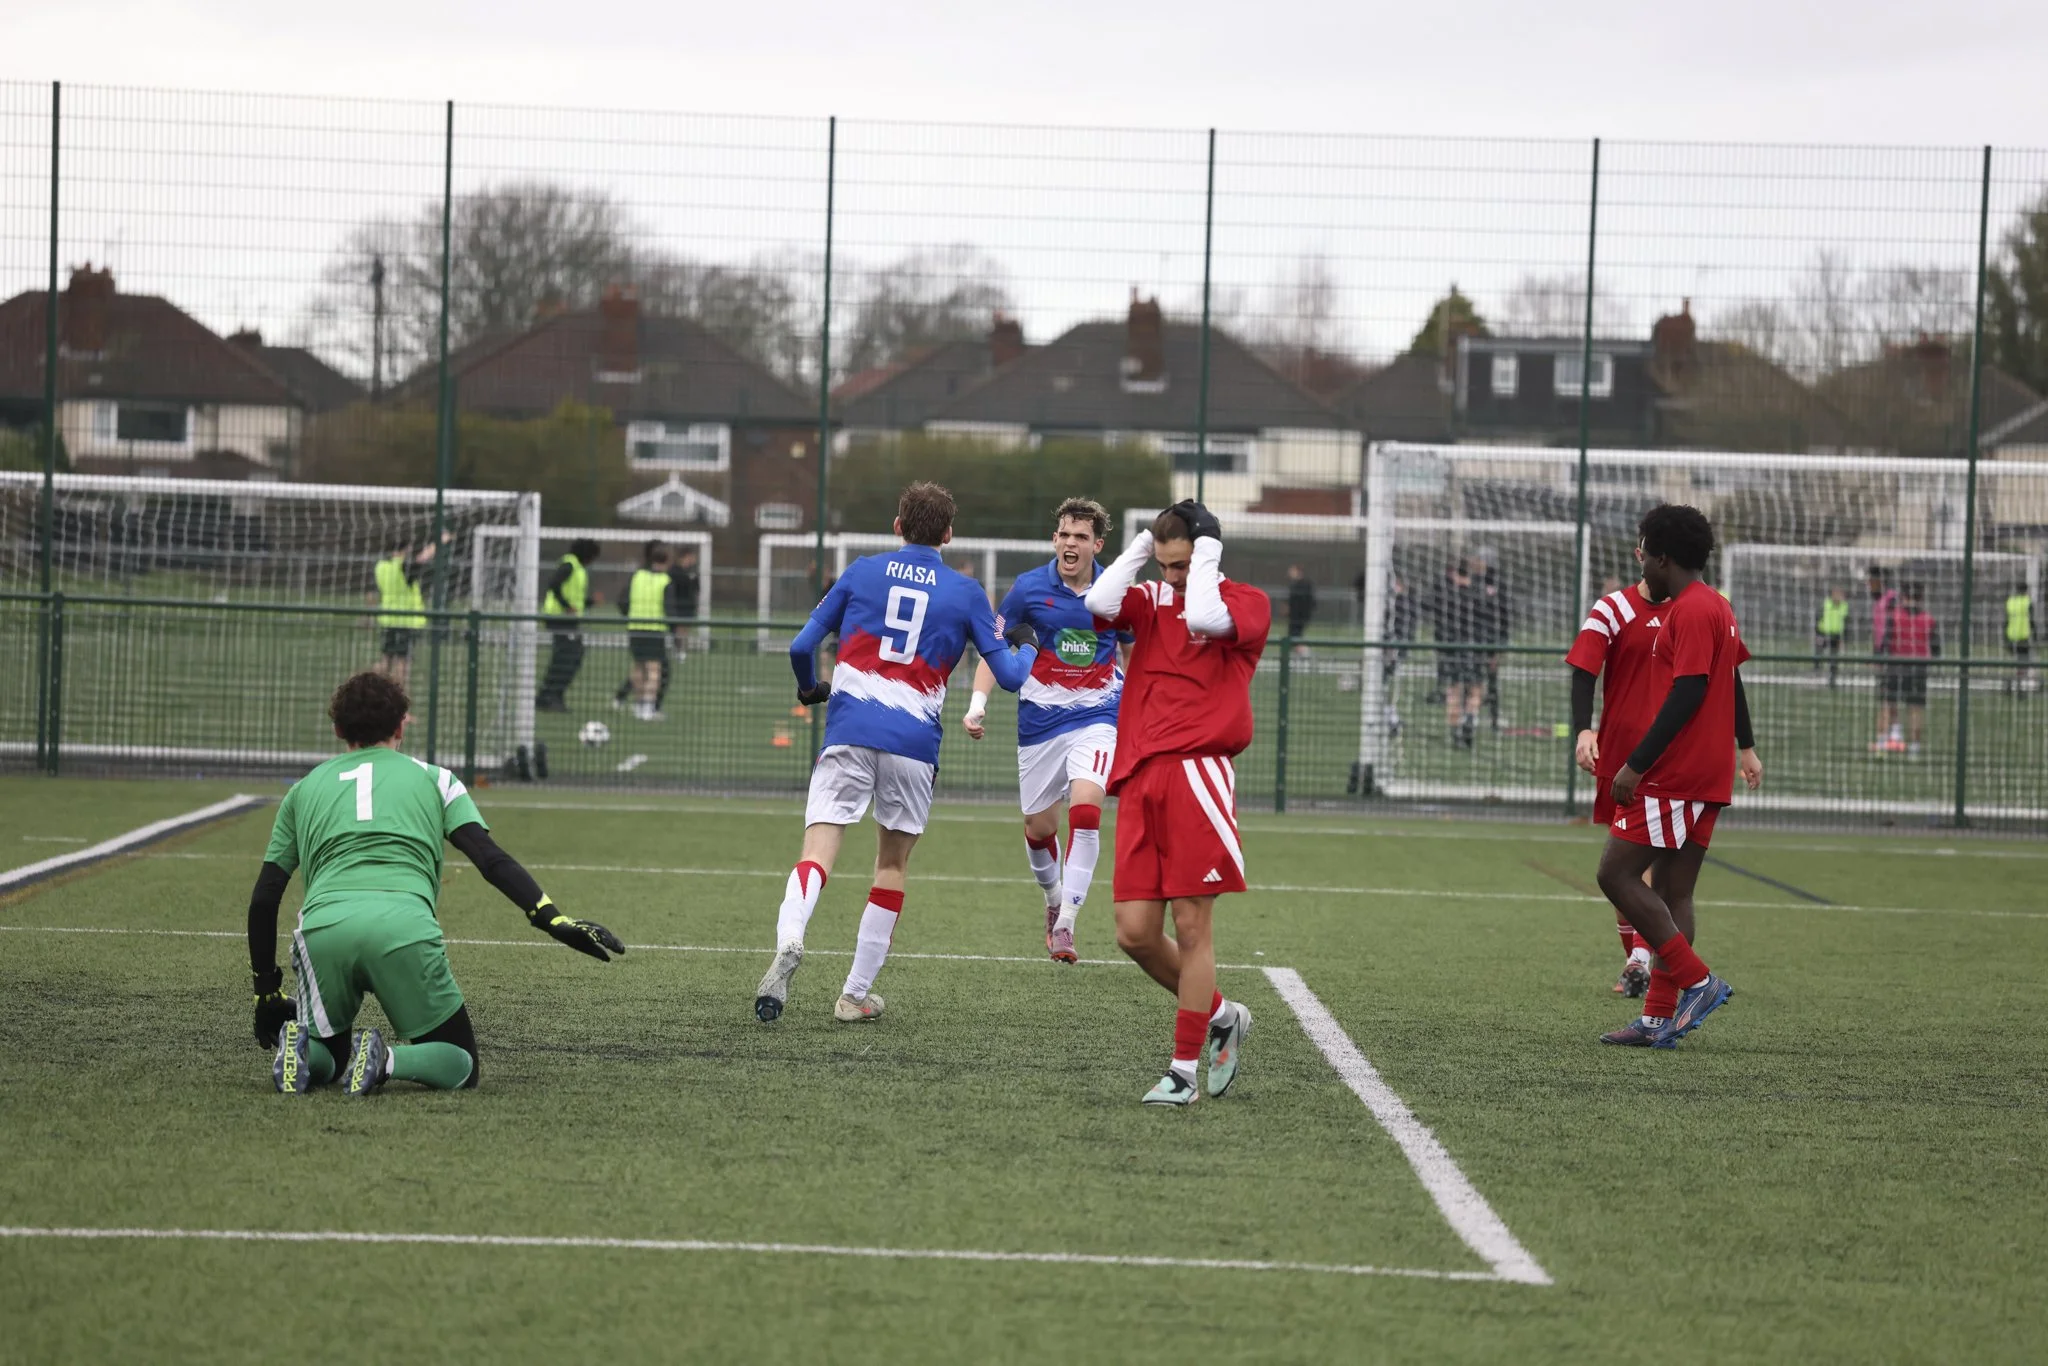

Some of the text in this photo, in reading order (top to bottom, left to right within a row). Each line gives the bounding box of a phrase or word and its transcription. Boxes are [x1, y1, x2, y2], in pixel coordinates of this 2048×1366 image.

[885, 560, 937, 586] RIASA
[878, 585, 930, 665] 9
[1061, 640, 1090, 652] think
[339, 762, 373, 821] 1
[1092, 749, 1108, 776] 11
[283, 1021, 300, 1092] PREDATOR
[351, 1030, 371, 1092] PREDATOR
